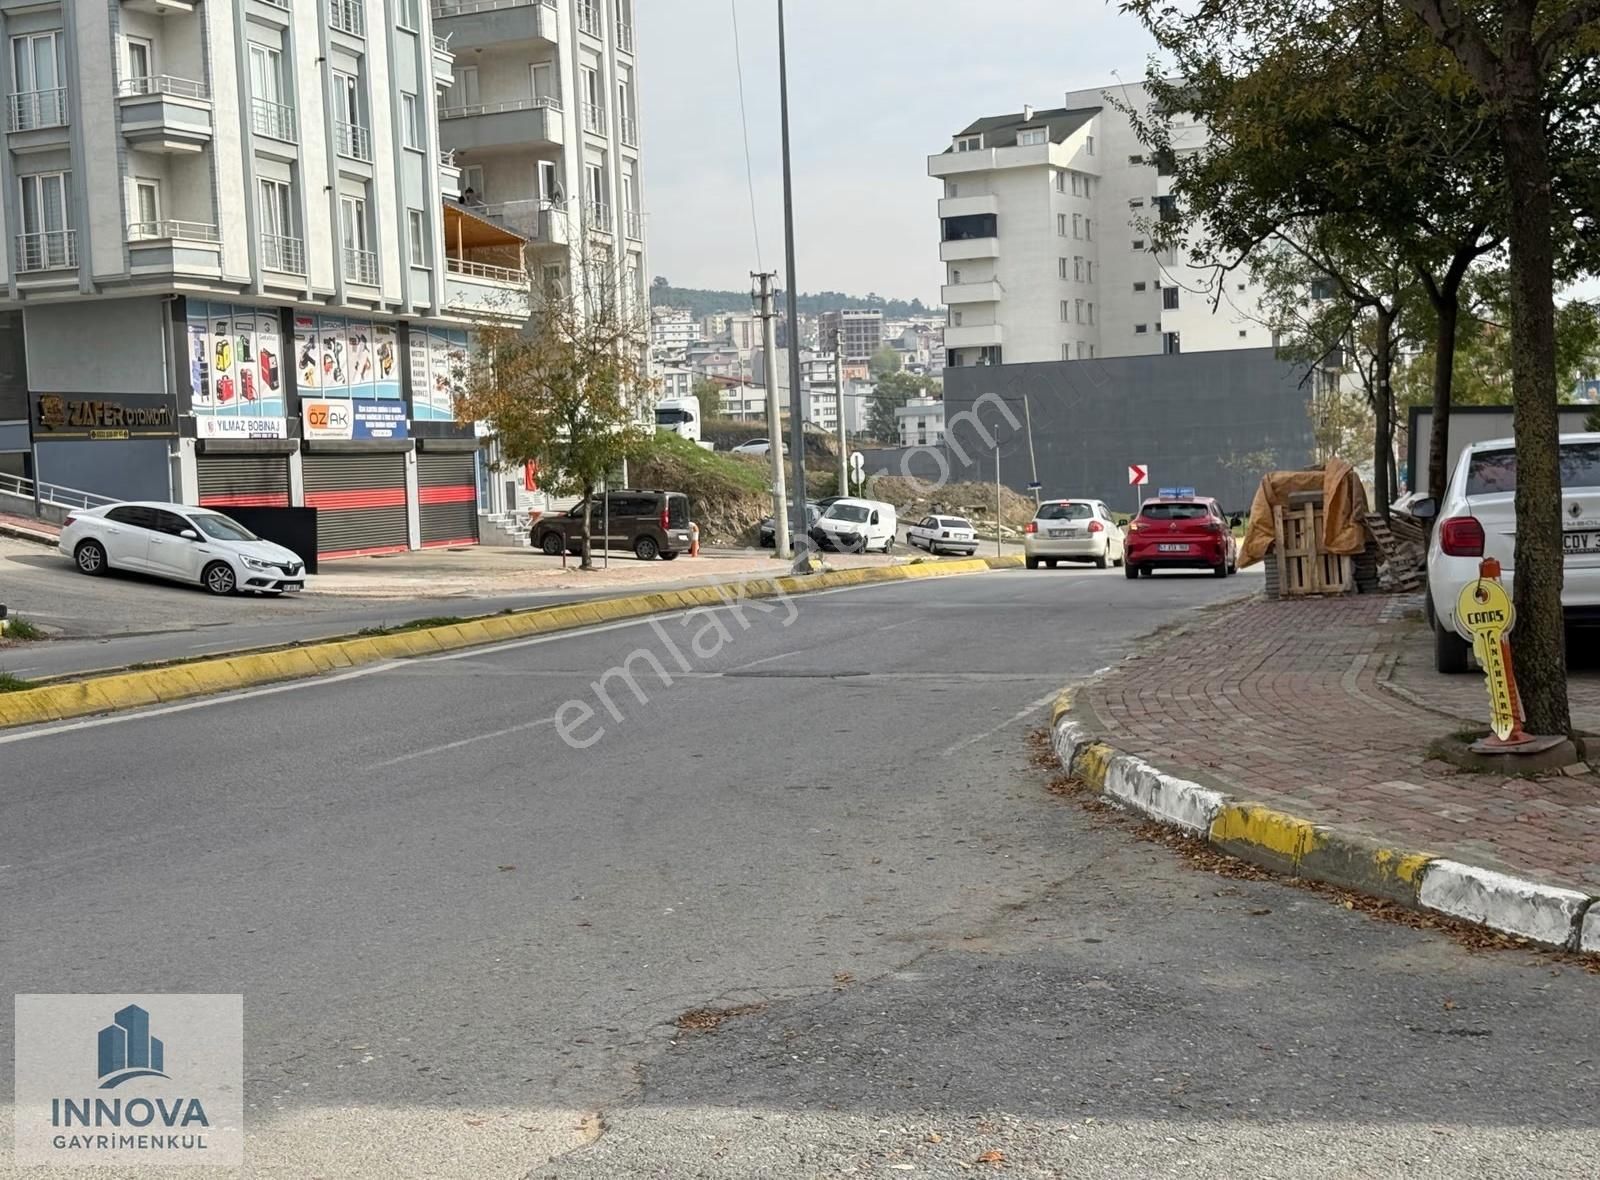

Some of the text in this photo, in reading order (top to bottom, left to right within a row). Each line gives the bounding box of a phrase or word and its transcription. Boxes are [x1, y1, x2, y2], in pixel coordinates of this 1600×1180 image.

[68, 401, 123, 425] ZAFER
[217, 420, 246, 432] YILMAZ
[1563, 535, 1588, 548] CDV
[1490, 637, 1509, 731] ANAHTARCI
